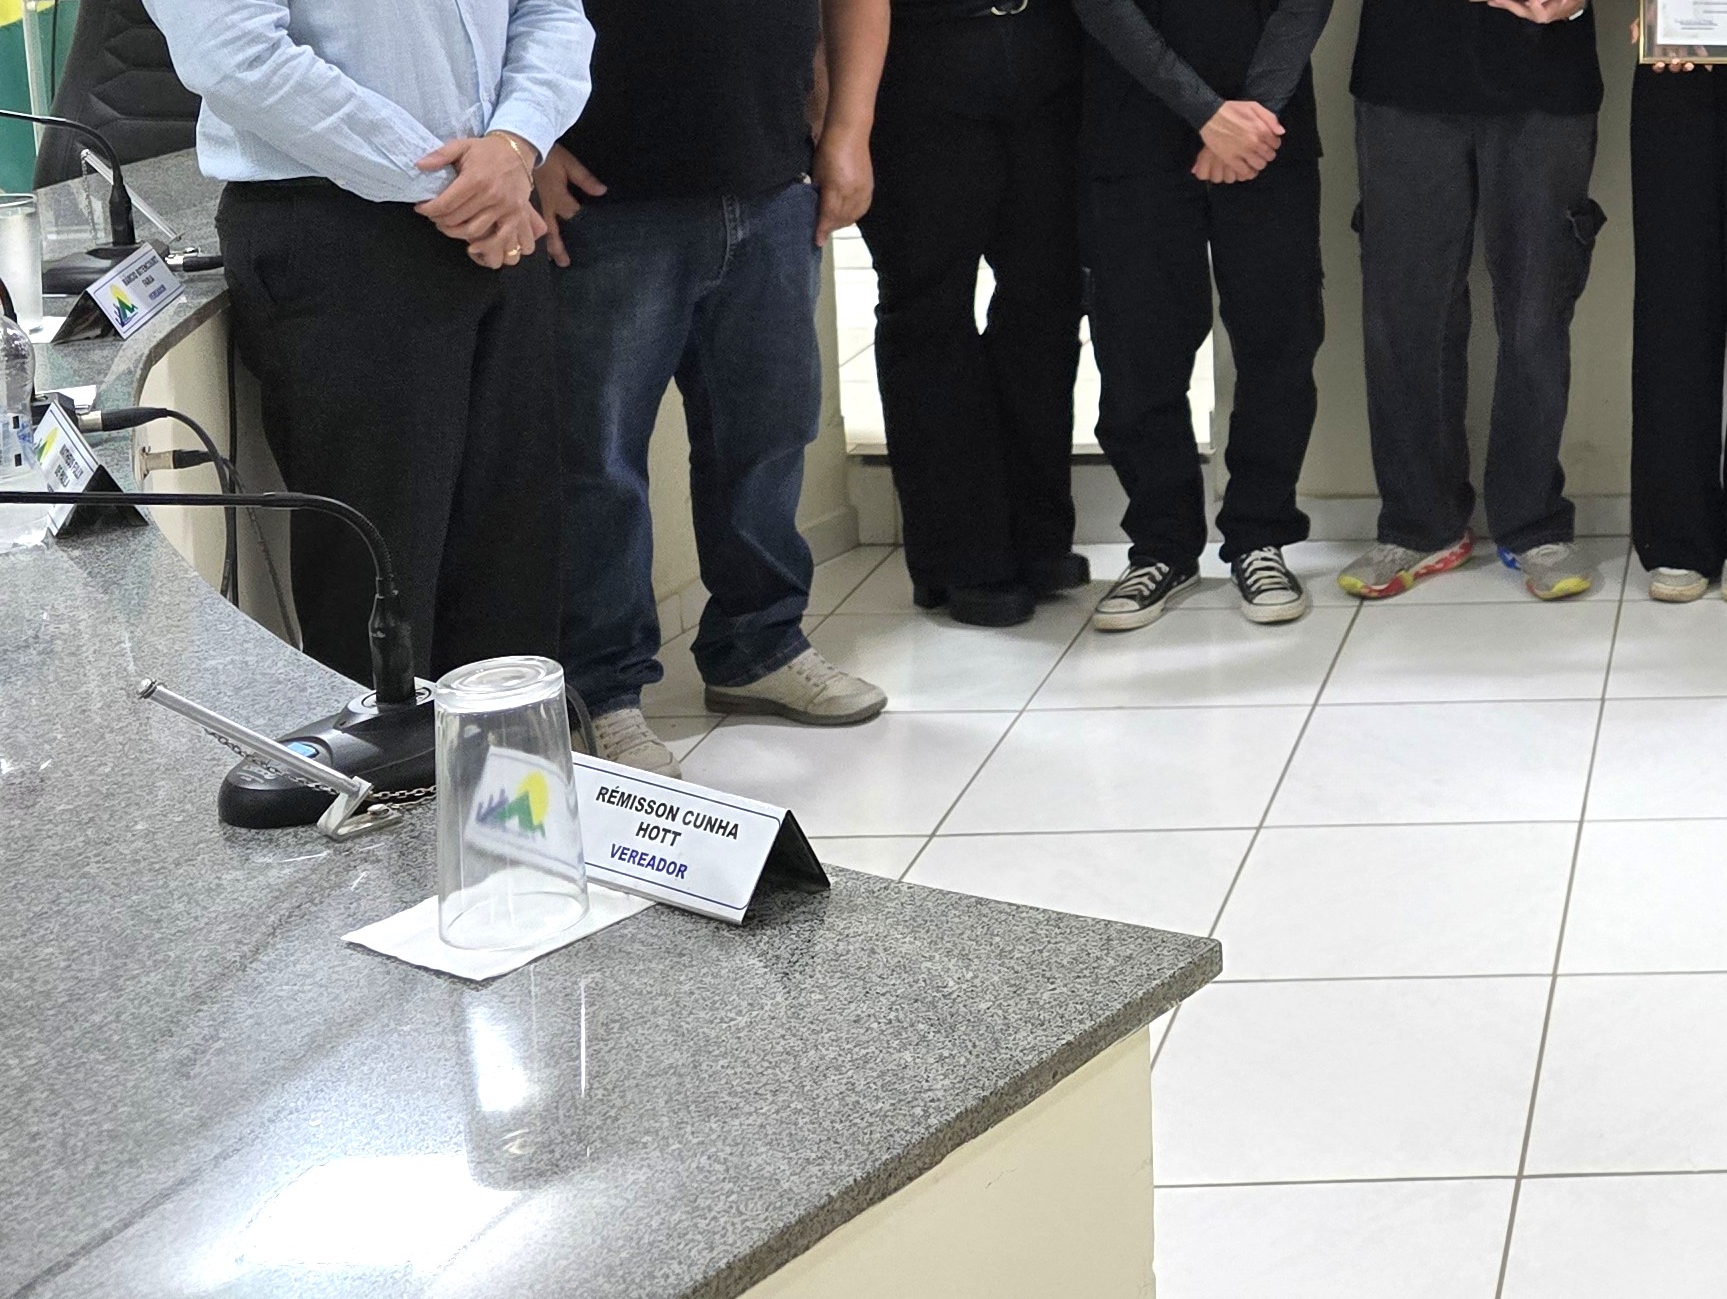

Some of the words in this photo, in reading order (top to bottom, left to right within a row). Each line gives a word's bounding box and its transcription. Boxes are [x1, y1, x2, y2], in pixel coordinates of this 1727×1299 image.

[595, 785, 680, 823] RÉMISSON
[682, 809, 740, 840] CUNHA
[635, 821, 682, 847] HOTT
[610, 843, 688, 880] VEREADOR
